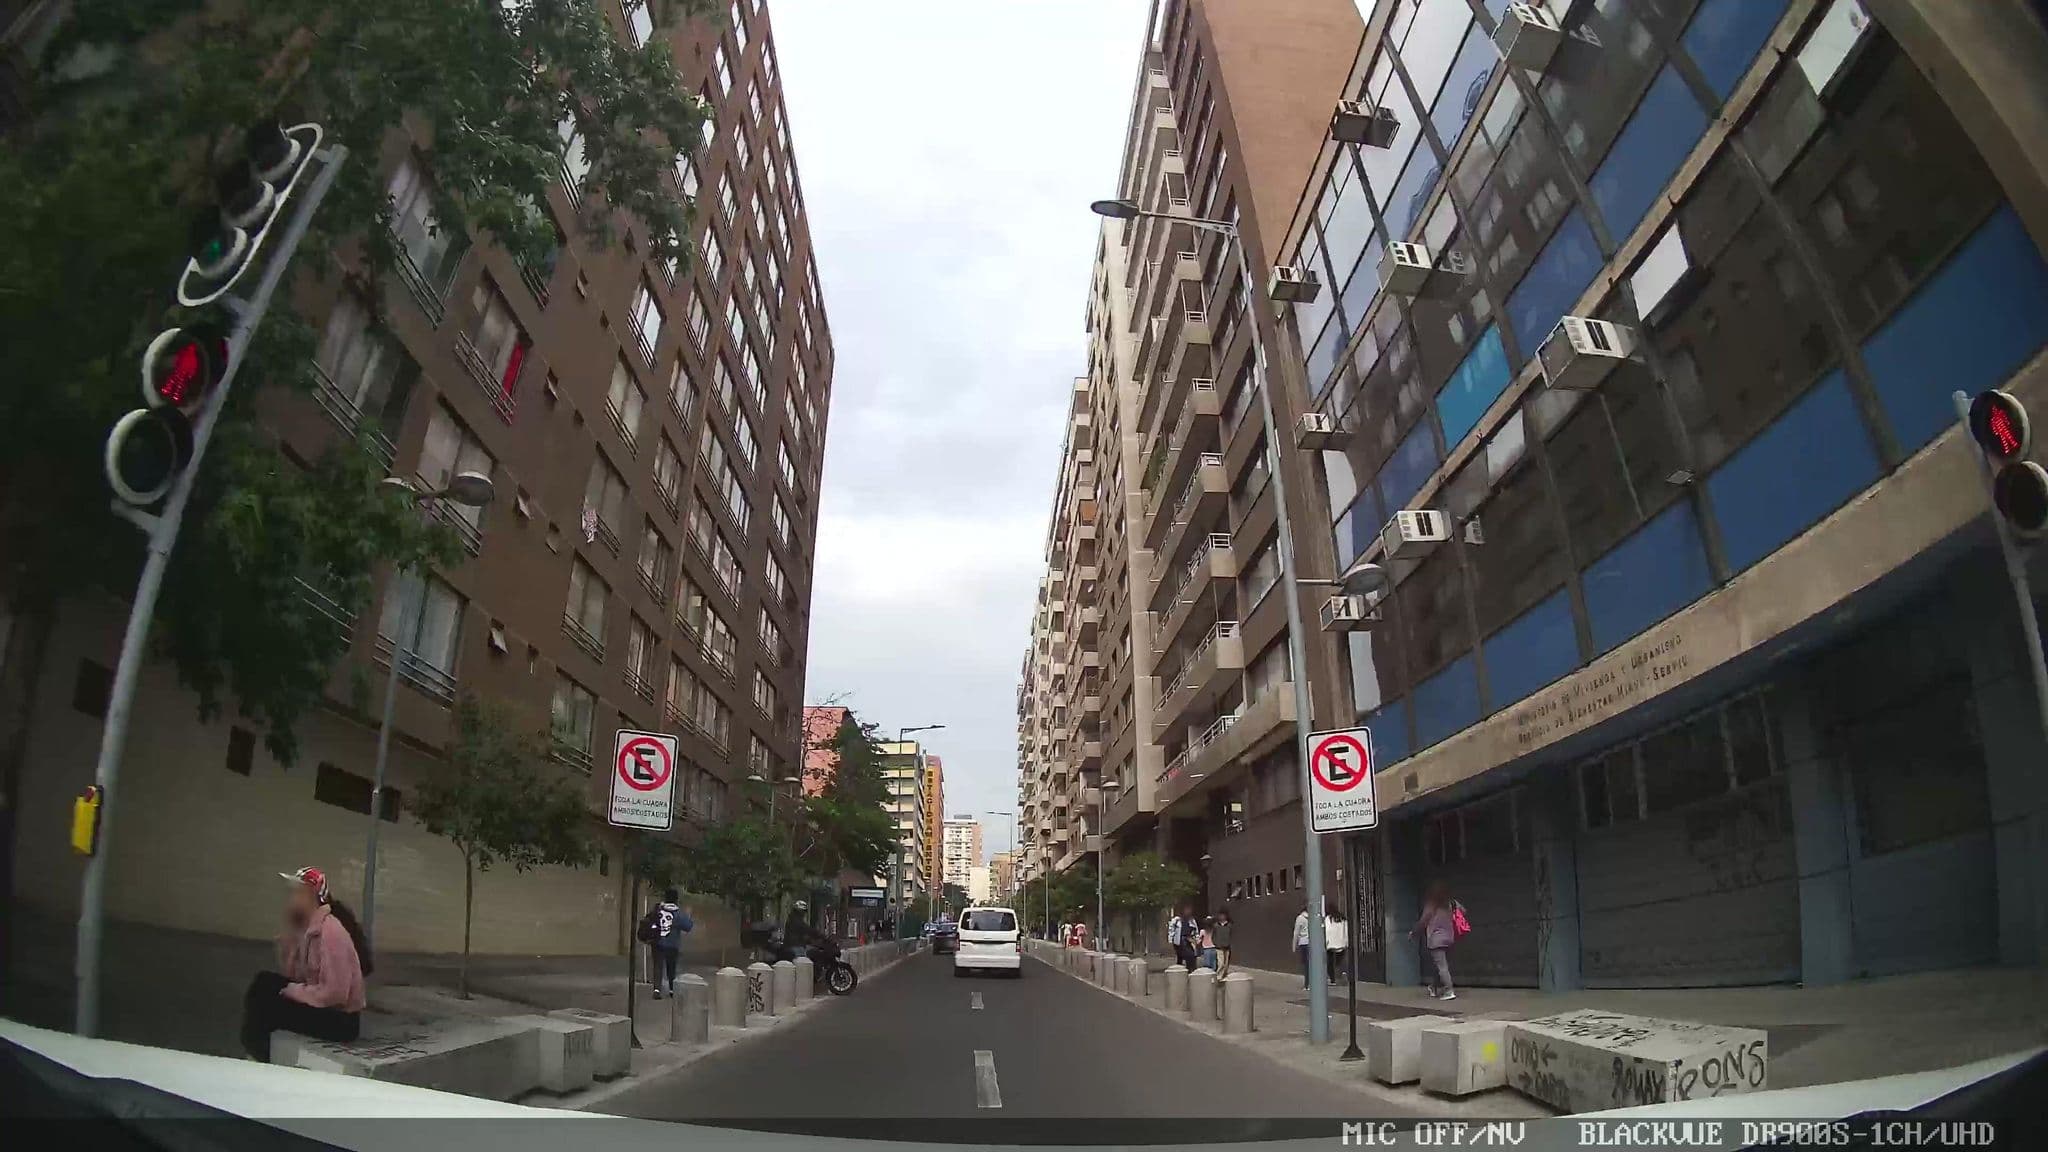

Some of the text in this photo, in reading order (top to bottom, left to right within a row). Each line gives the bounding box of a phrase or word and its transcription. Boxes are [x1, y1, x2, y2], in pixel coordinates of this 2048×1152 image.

[1573, 671, 1616, 697] VIVIENDA
[1630, 634, 1682, 669] URBANISMO
[614, 795, 668, 808] TODA LA CUADRA
[1315, 797, 1372, 810] TODA LA CUADRA
[613, 807, 669, 819] AMBOS COSTADOS
[1315, 809, 1373, 821] AMBOS COSTADOS
